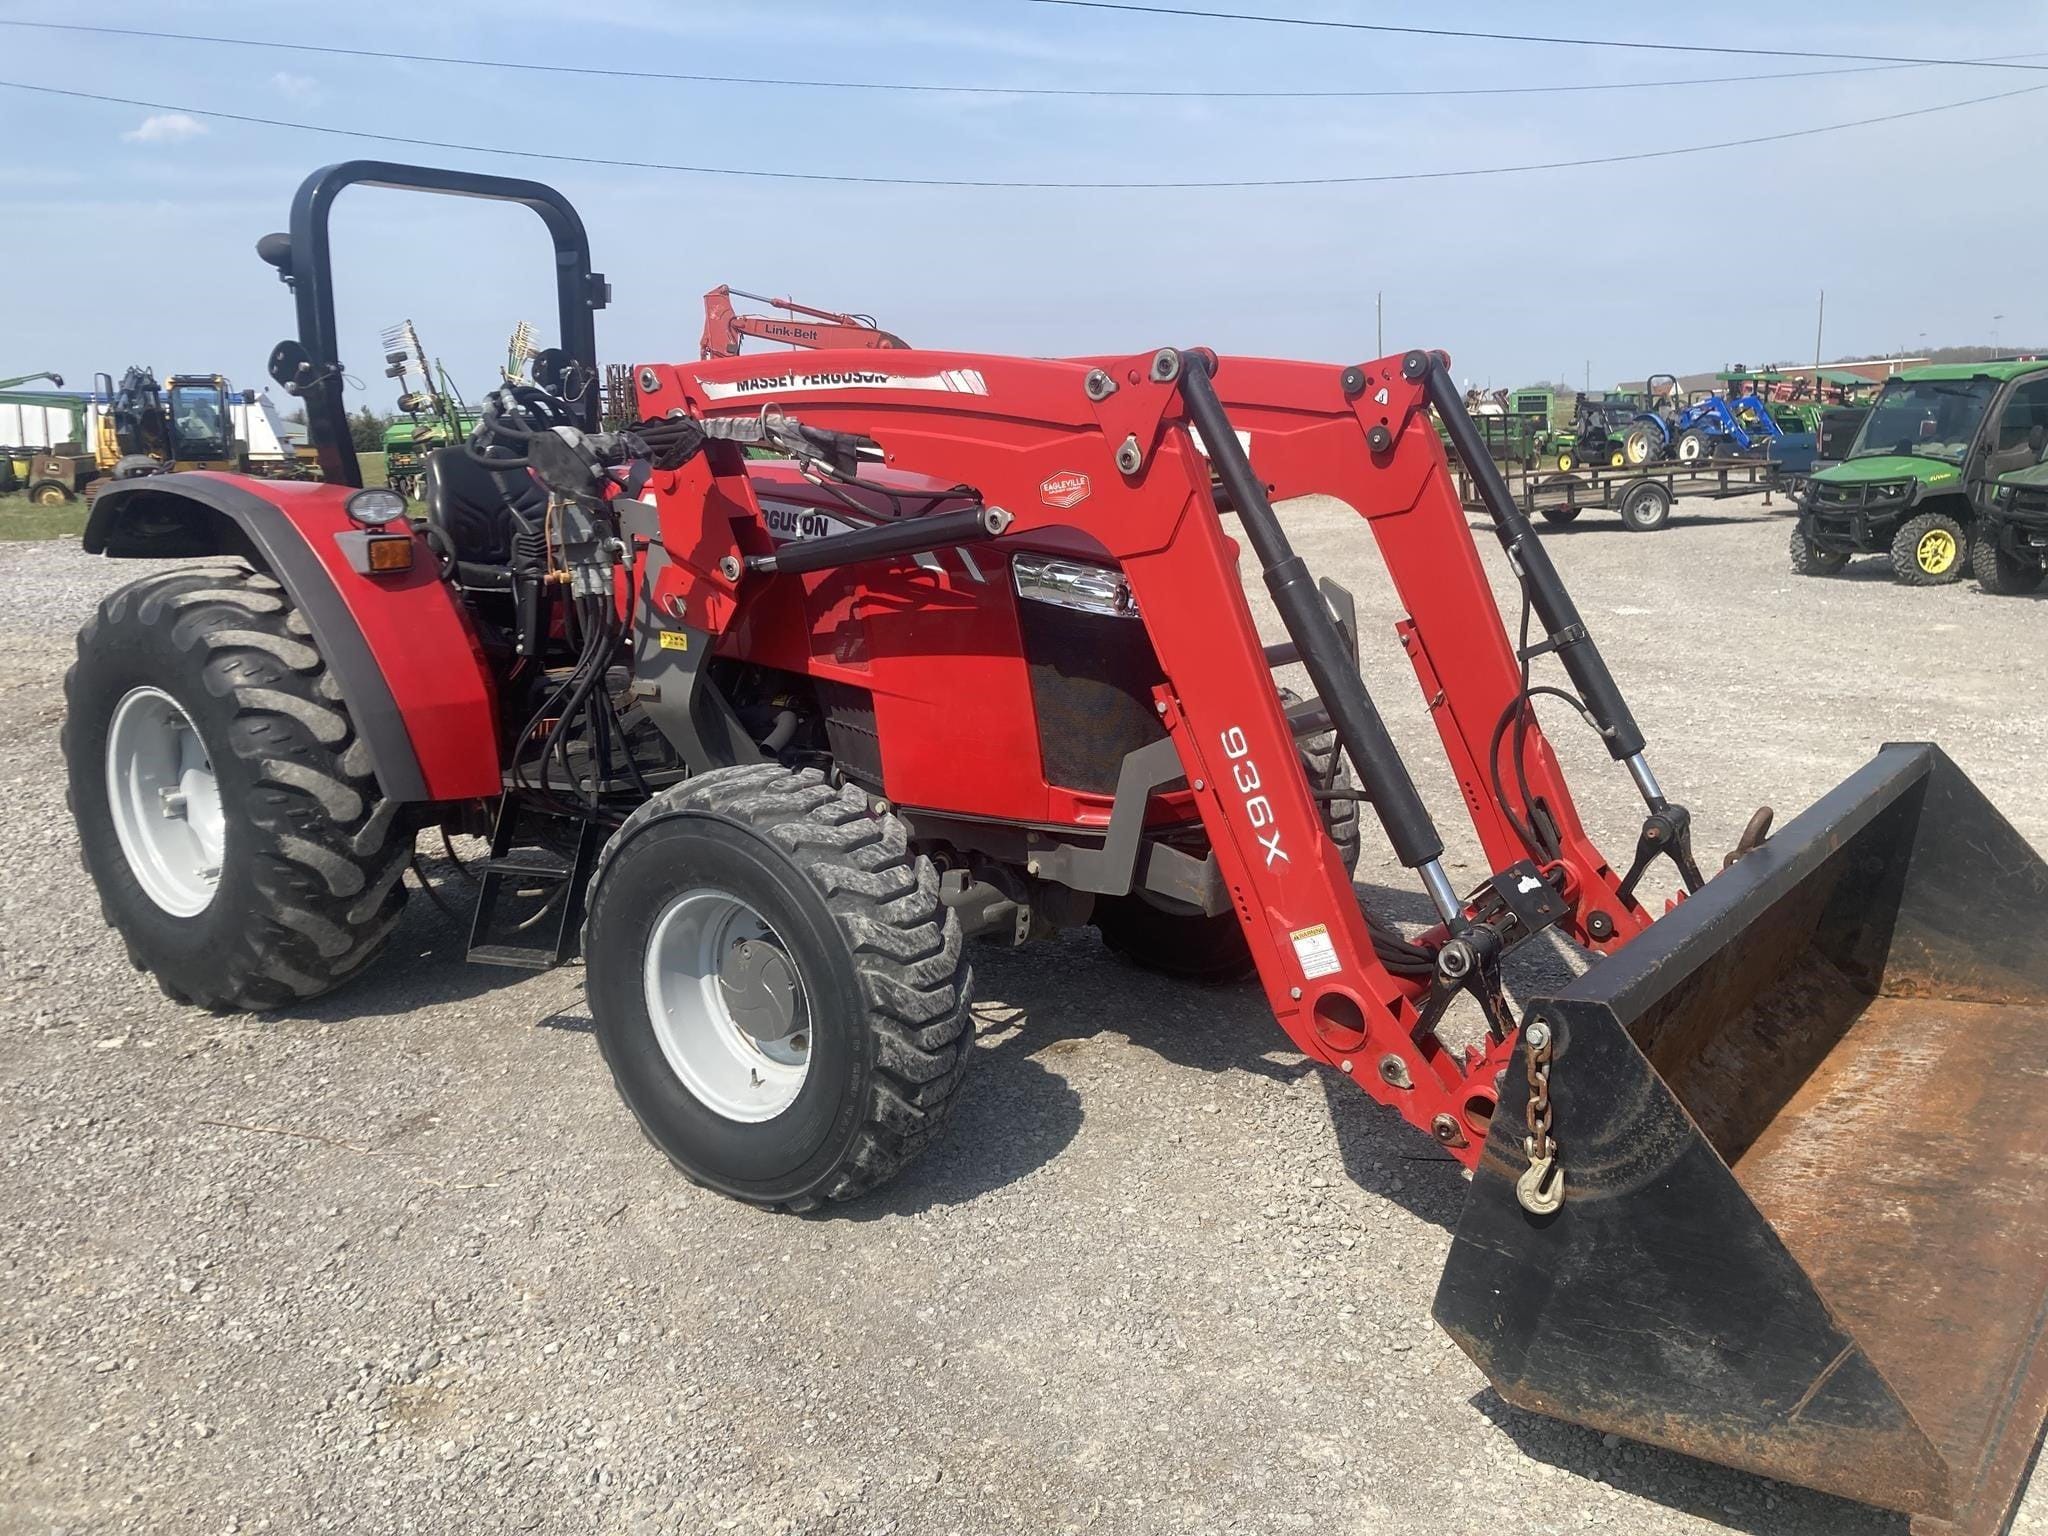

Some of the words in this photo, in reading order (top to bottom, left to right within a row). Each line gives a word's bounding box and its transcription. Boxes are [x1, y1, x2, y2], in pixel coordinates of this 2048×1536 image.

[765, 324, 817, 340] Link-Belt
[1043, 477, 1086, 491] EAGLEVILLE
[1220, 726, 1291, 867] 936X
